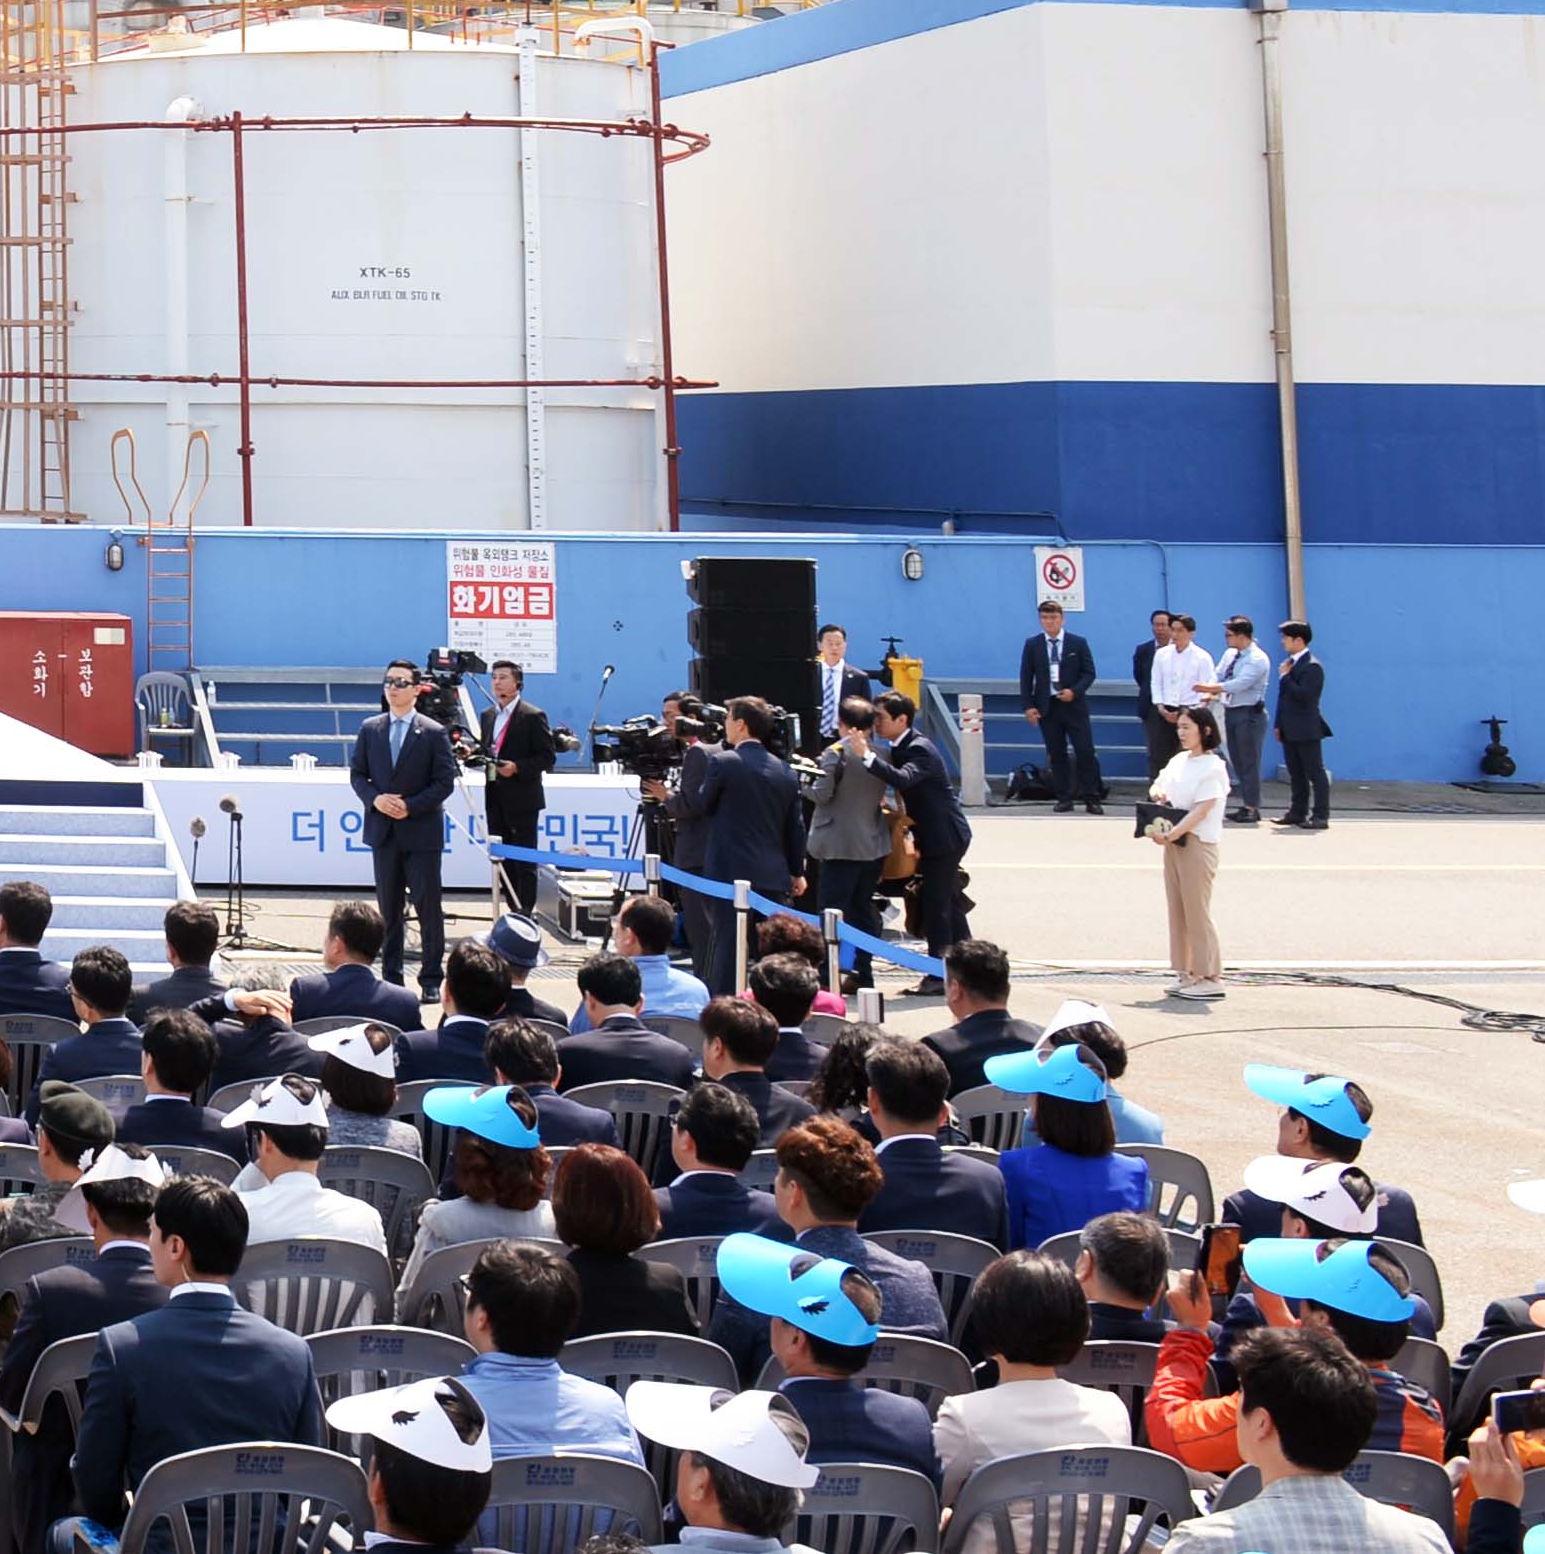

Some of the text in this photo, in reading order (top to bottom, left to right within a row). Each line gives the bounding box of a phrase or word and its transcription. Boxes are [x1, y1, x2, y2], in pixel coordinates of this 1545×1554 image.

[359, 266, 411, 279] XTK-65
[372, 290, 392, 300] FUEL
[395, 290, 407, 300] OIL
[453, 547, 479, 562] 위험물
[453, 564, 485, 578] 위험물
[490, 564, 523, 579] 인화성
[452, 585, 550, 615] 화기엄금
[291, 809, 325, 853] 더
